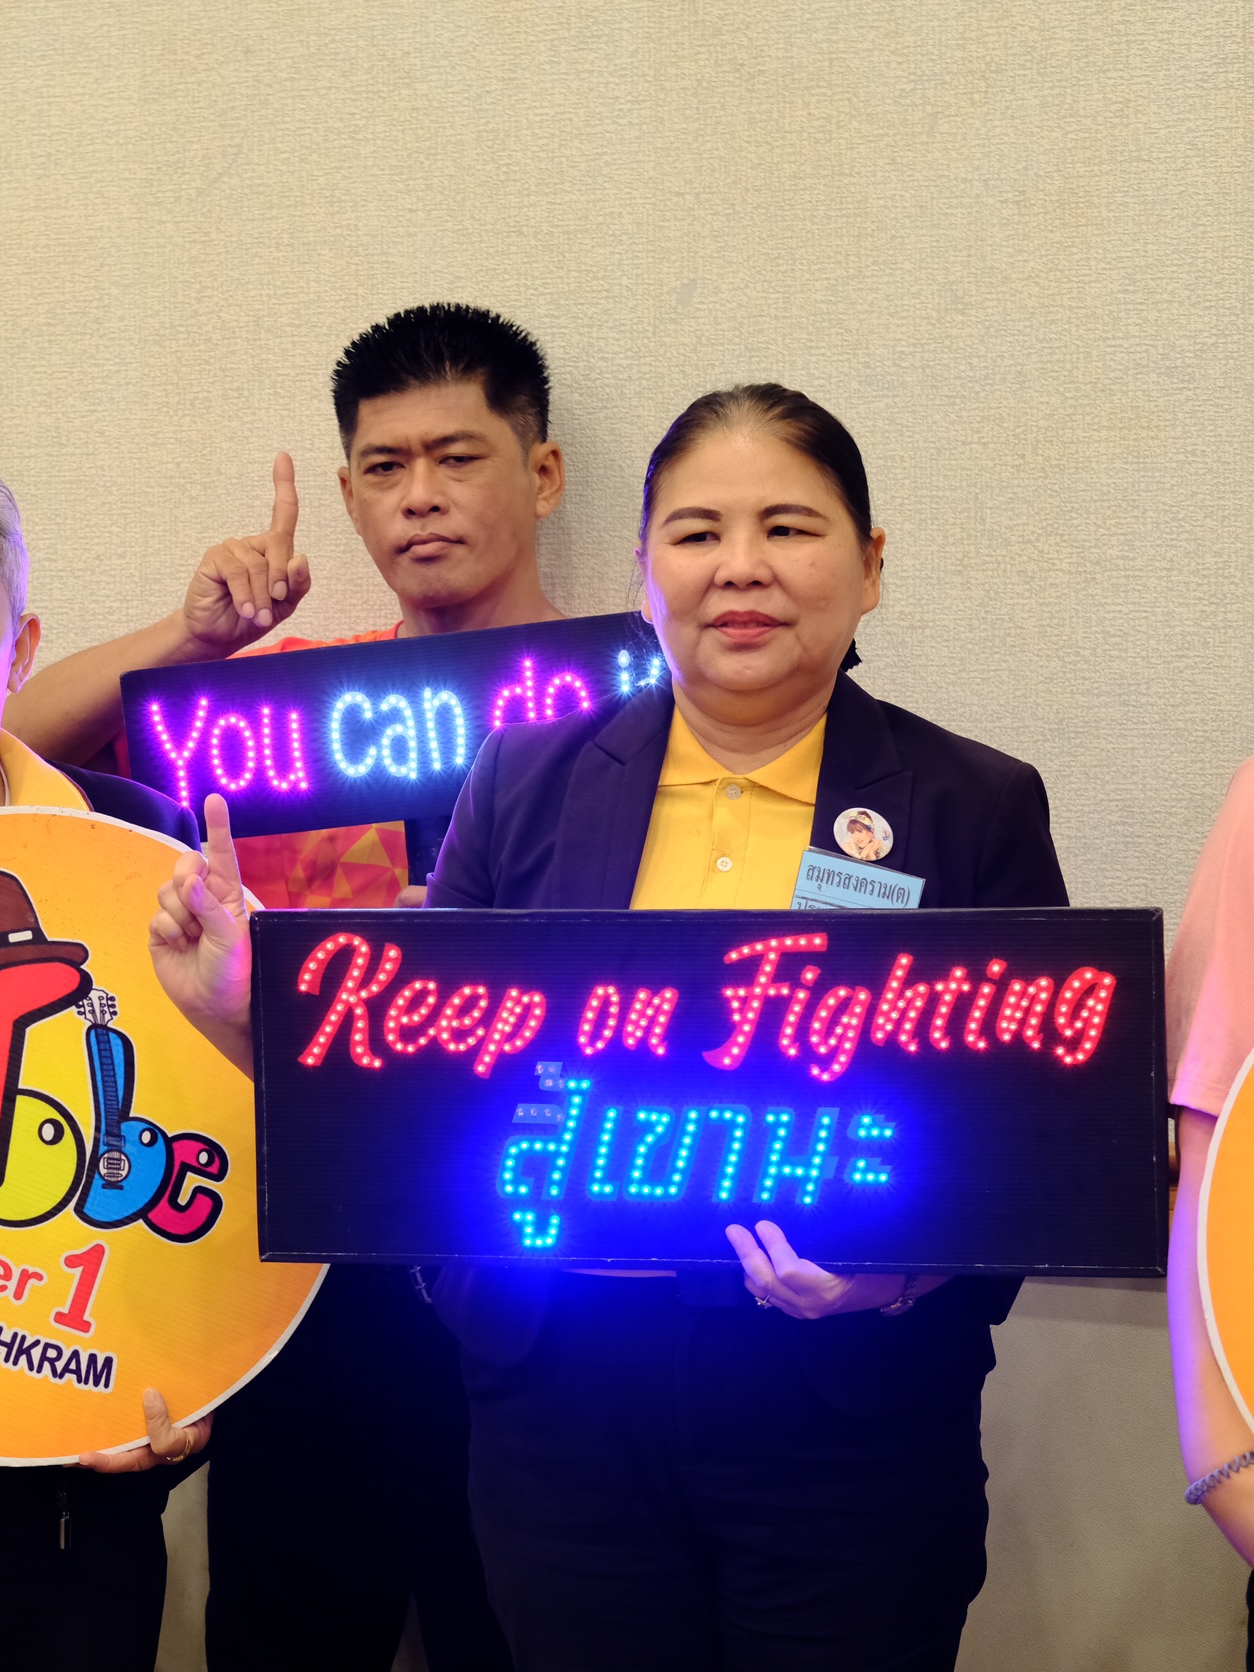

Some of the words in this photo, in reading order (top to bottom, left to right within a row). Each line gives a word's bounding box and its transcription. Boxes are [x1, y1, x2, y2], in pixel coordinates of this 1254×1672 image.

[149, 696, 309, 809] You
[805, 863, 911, 907] สมุทรสงคราม(ต)
[297, 931, 548, 1080] Keep
[577, 985, 680, 1056] on
[702, 932, 1117, 1082] Fighting
[495, 1060, 896, 1249] สู้เขานะ
[53, 1242, 107, 1334] 1
